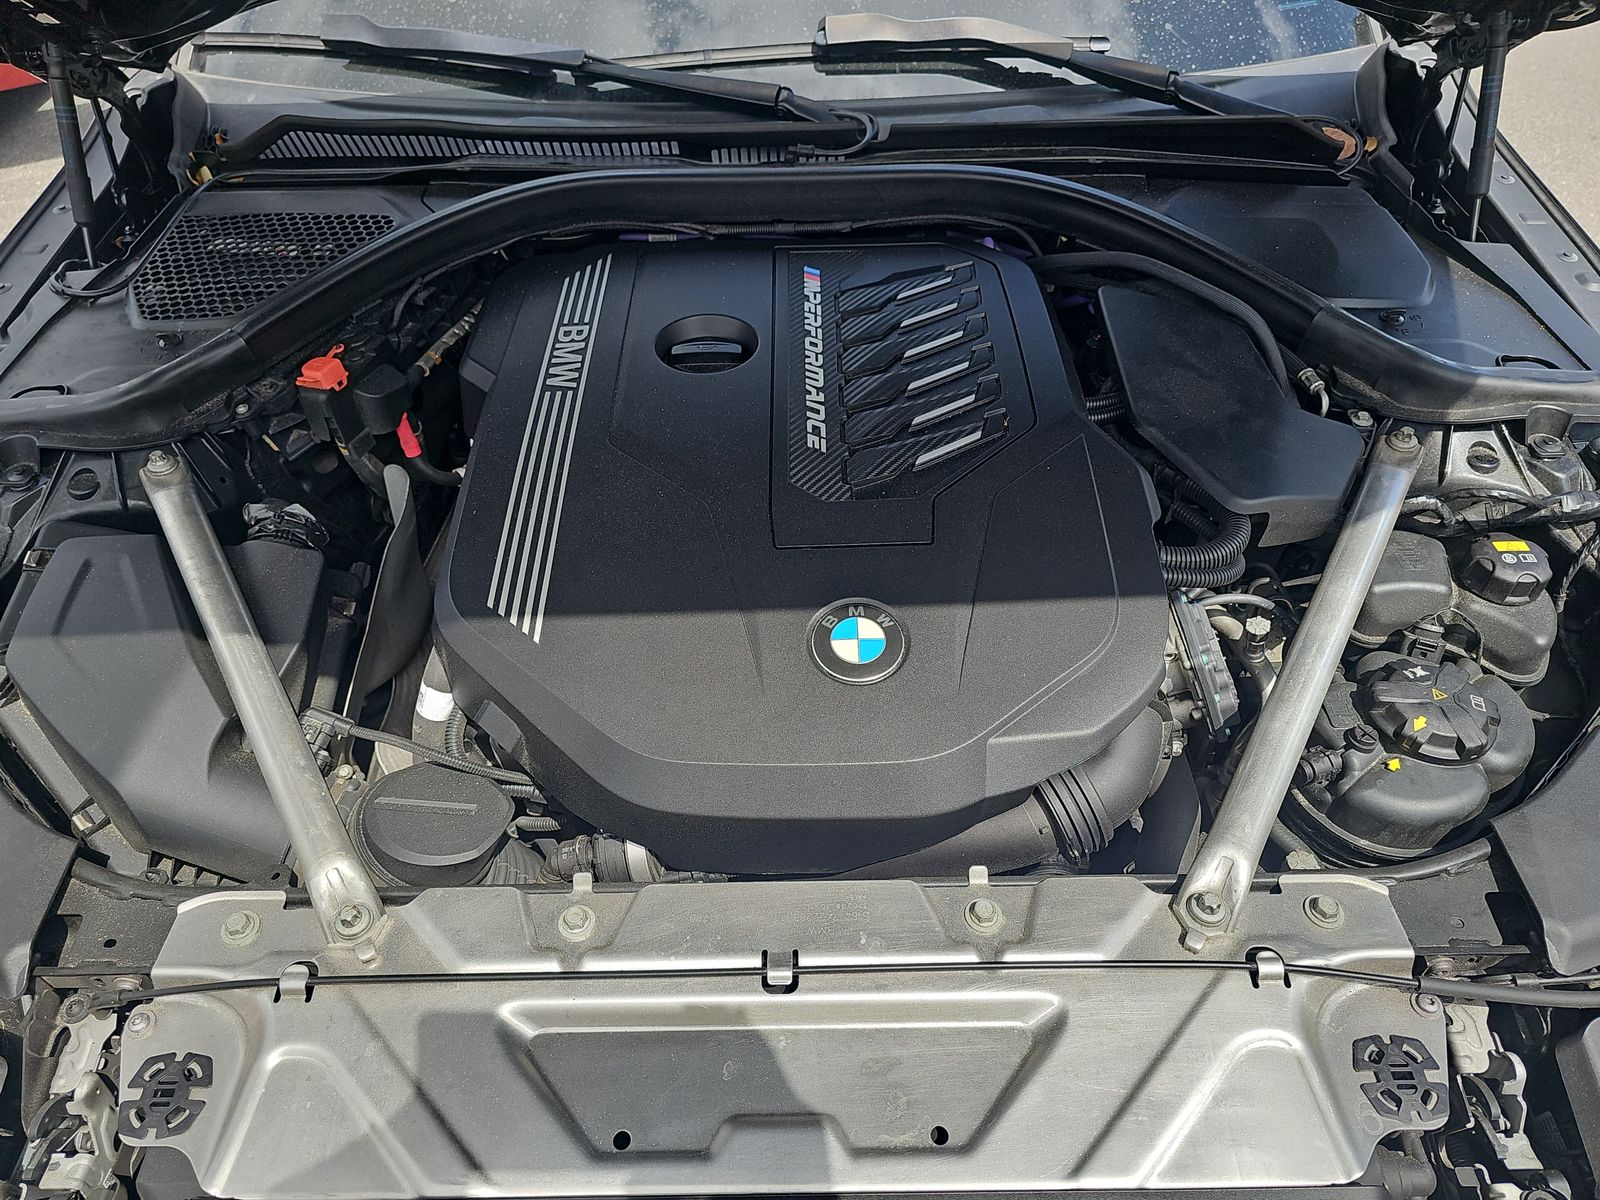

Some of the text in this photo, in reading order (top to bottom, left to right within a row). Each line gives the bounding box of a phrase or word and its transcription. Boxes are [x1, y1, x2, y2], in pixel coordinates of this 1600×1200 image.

[545, 324, 590, 389] BMW
[803, 292, 827, 453] PERFORMANCE
[821, 605, 895, 630] BMW
